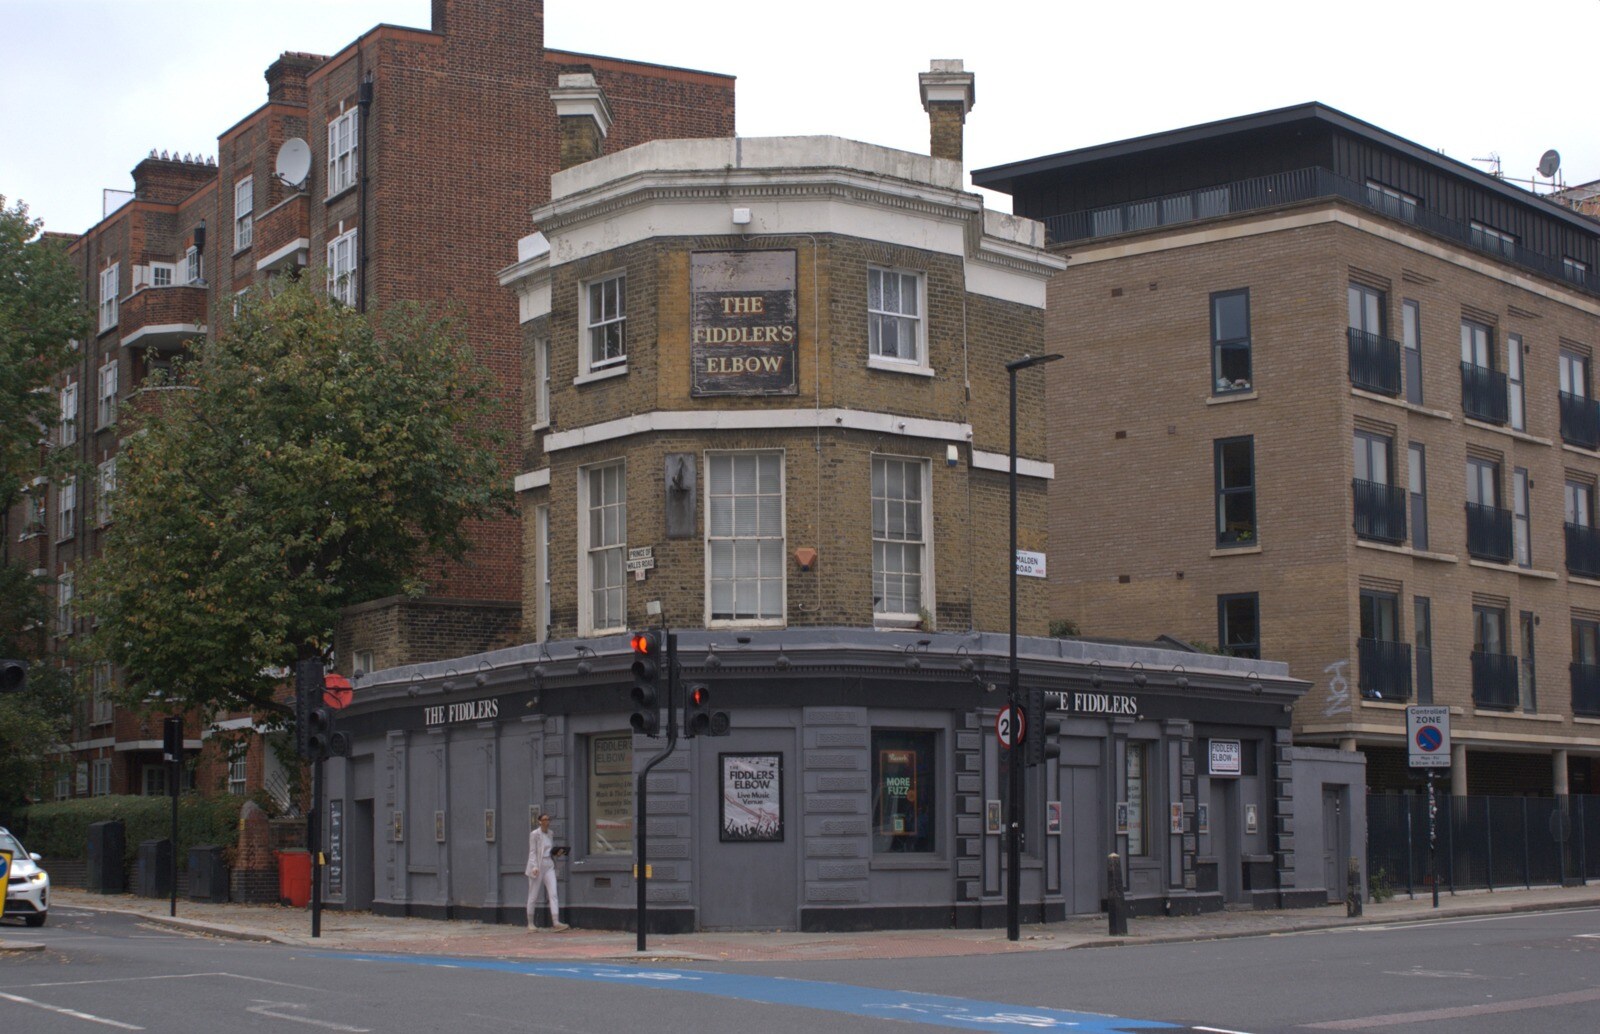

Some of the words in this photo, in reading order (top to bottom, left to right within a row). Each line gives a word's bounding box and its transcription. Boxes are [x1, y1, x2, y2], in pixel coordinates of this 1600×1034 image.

[720, 296, 763, 314] THE
[693, 326, 793, 344] FIDDLER'S
[706, 356, 783, 373] ELBOW
[1016, 556, 1038, 565] MALDEN
[1016, 565, 1032, 573] ROAD
[1074, 692, 1138, 715] FIDDLERS
[424, 705, 445, 725] THE
[448, 698, 499, 722] FIDDLERS
[1416, 716, 1441, 724] ZONE
[597, 752, 625, 762] ELBOW
[1212, 753, 1232, 762] ELBOW
[730, 771, 774, 780] FIDDLERS
[734, 781, 770, 789] ELBOW
[886, 777, 911, 786] MORE
[752, 791, 769, 799] Music
[888, 786, 909, 796] FUZZ
